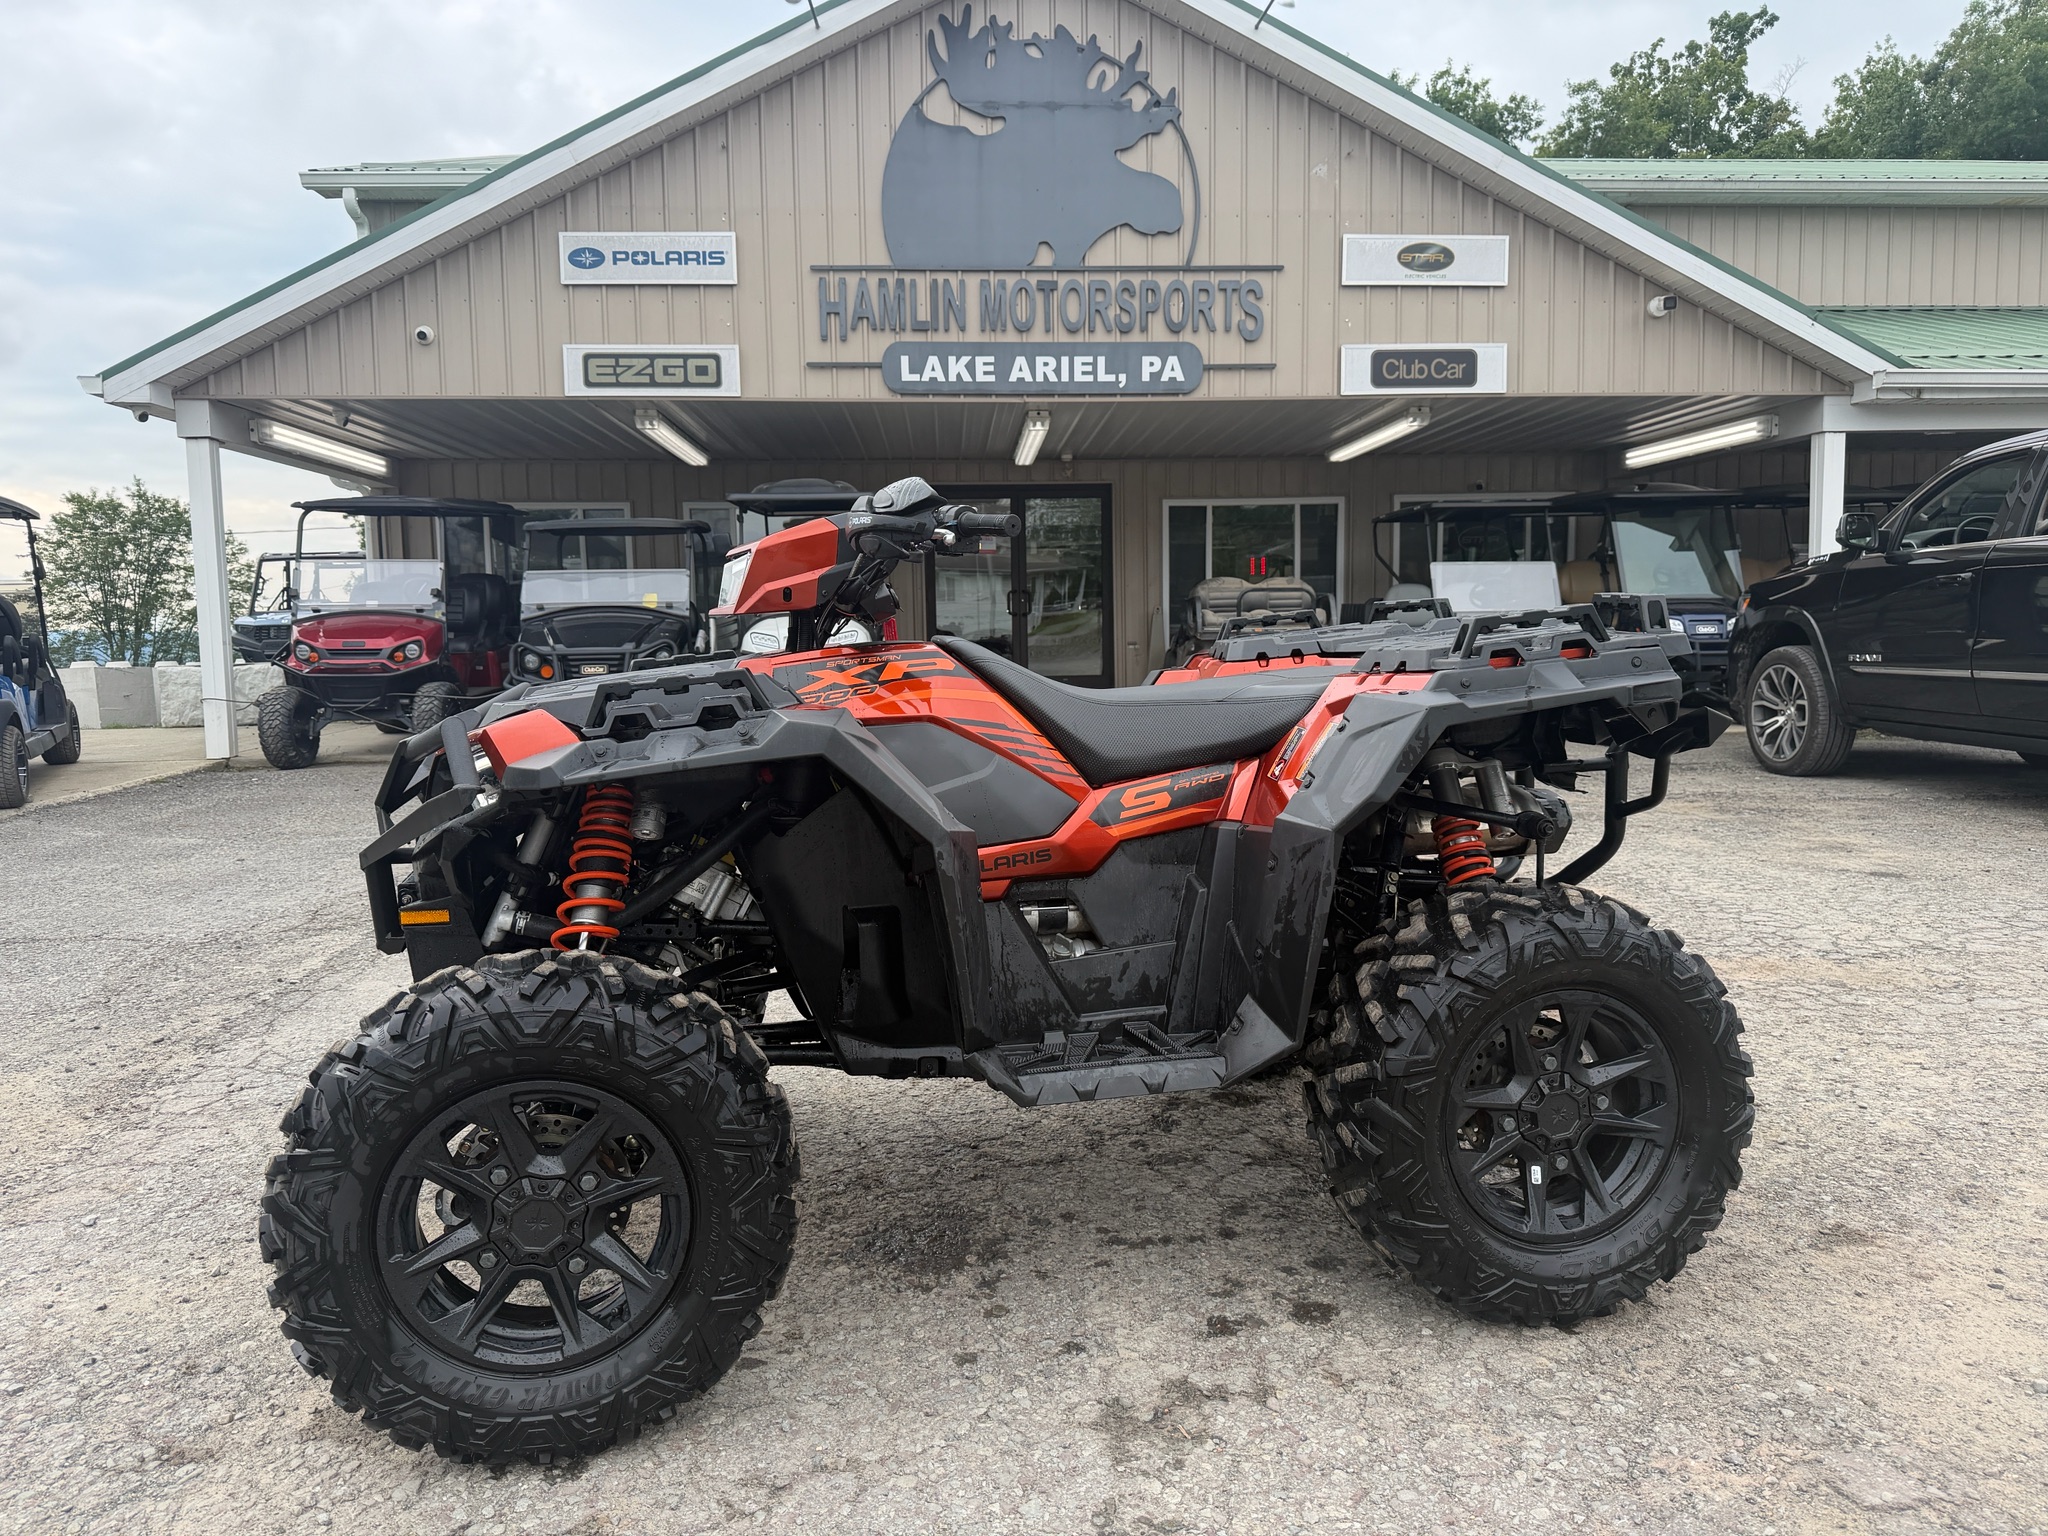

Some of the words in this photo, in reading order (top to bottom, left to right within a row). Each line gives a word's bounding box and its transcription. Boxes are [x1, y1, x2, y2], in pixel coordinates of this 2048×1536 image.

[612, 250, 726, 266] POLARIS
[1400, 252, 1445, 265] STAR
[818, 276, 966, 341] HAMLIN
[979, 277, 1265, 343] MOTORSPORTS
[899, 355, 996, 383] LAKE
[1008, 355, 1127, 389] ARIEL,
[1140, 355, 1186, 383] PA
[1382, 358, 1429, 380] Club
[1430, 358, 1467, 380] Car
[795, 658, 956, 694] XP
[826, 655, 902, 668] SPORTSMAN
[800, 684, 880, 705] 000
[1173, 773, 1225, 791] AWD
[1119, 778, 1172, 819] S
[979, 847, 1053, 873] LARIS
[1559, 1218, 1663, 1279] DURO
[431, 1375, 511, 1410] GRIP
[517, 1360, 625, 1411] POWER
